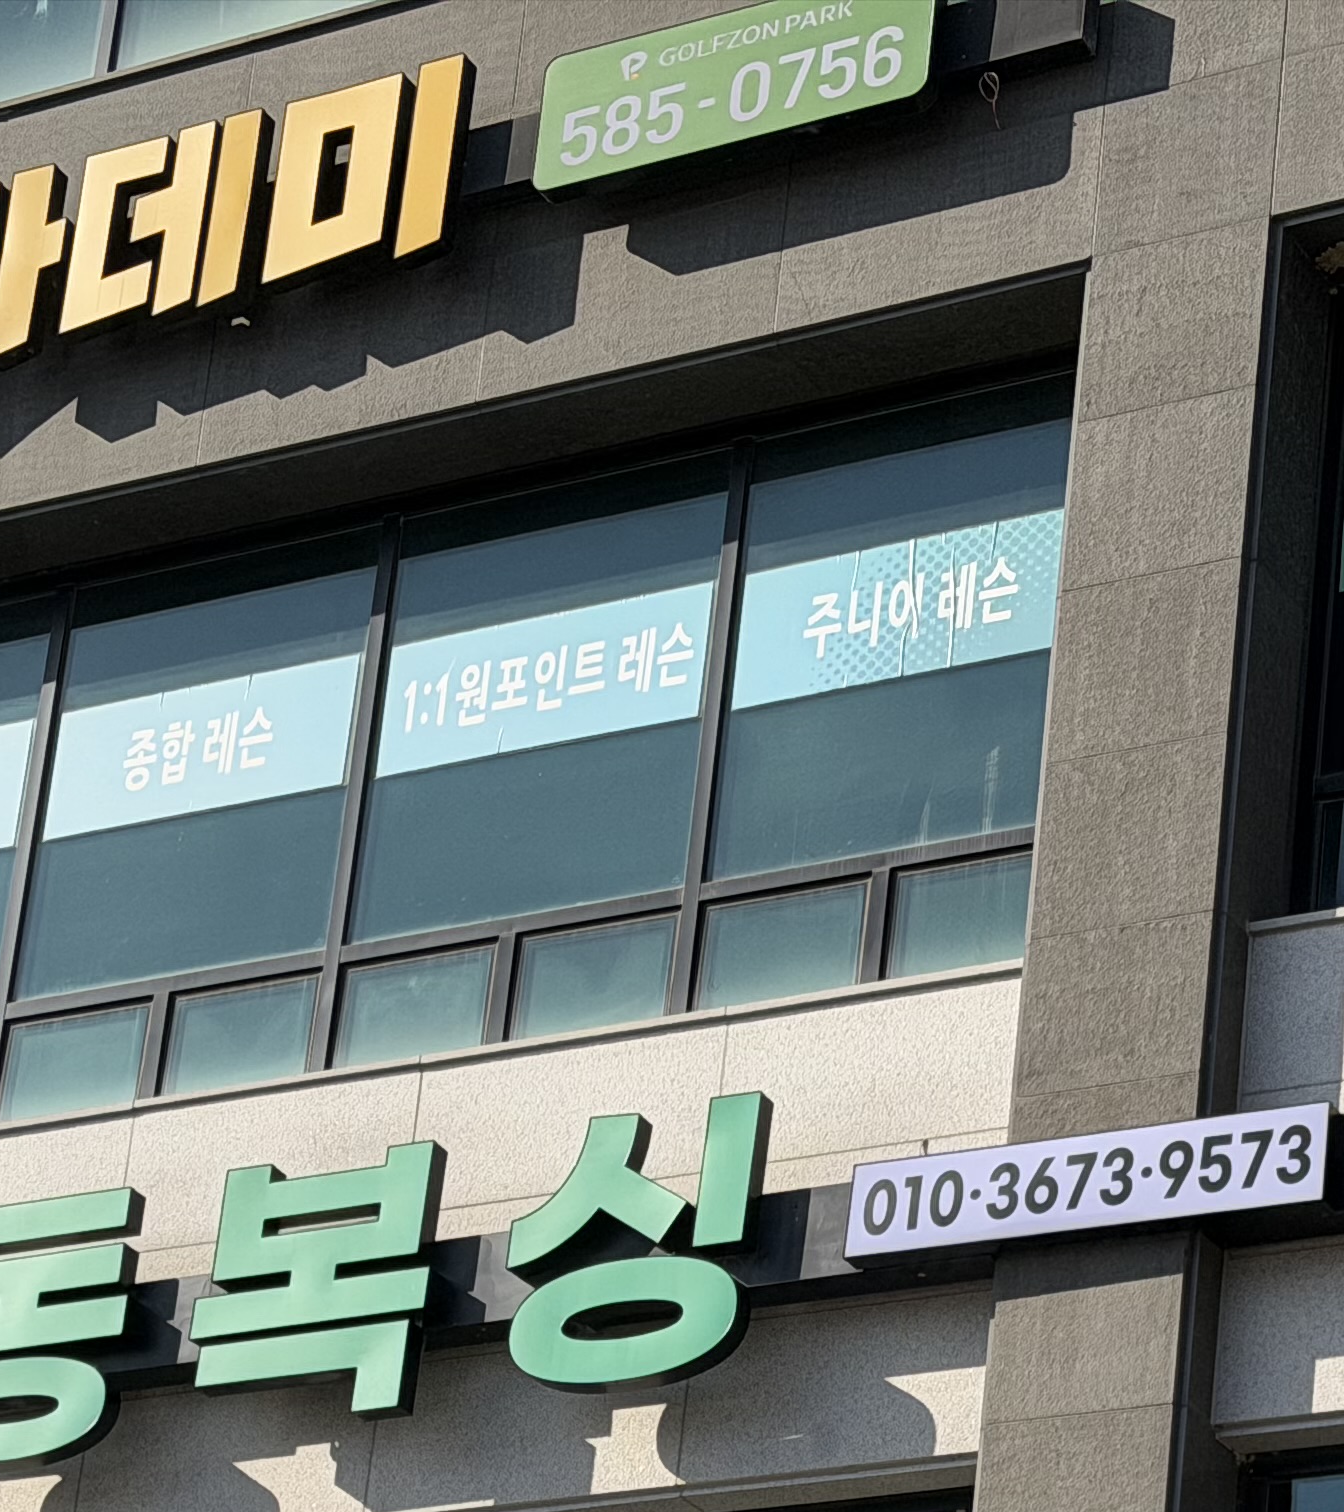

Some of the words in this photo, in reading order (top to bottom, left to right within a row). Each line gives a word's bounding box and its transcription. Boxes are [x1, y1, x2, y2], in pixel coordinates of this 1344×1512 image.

[658, 18, 780, 68] GOLFZON
[785, 0, 853, 34] PARK
[559, 25, 905, 167] 585-0756
[937, 556, 1019, 630] 레슨
[616, 622, 695, 693] 레슨
[121, 722, 195, 793] 종합
[202, 705, 275, 776] 레슨
